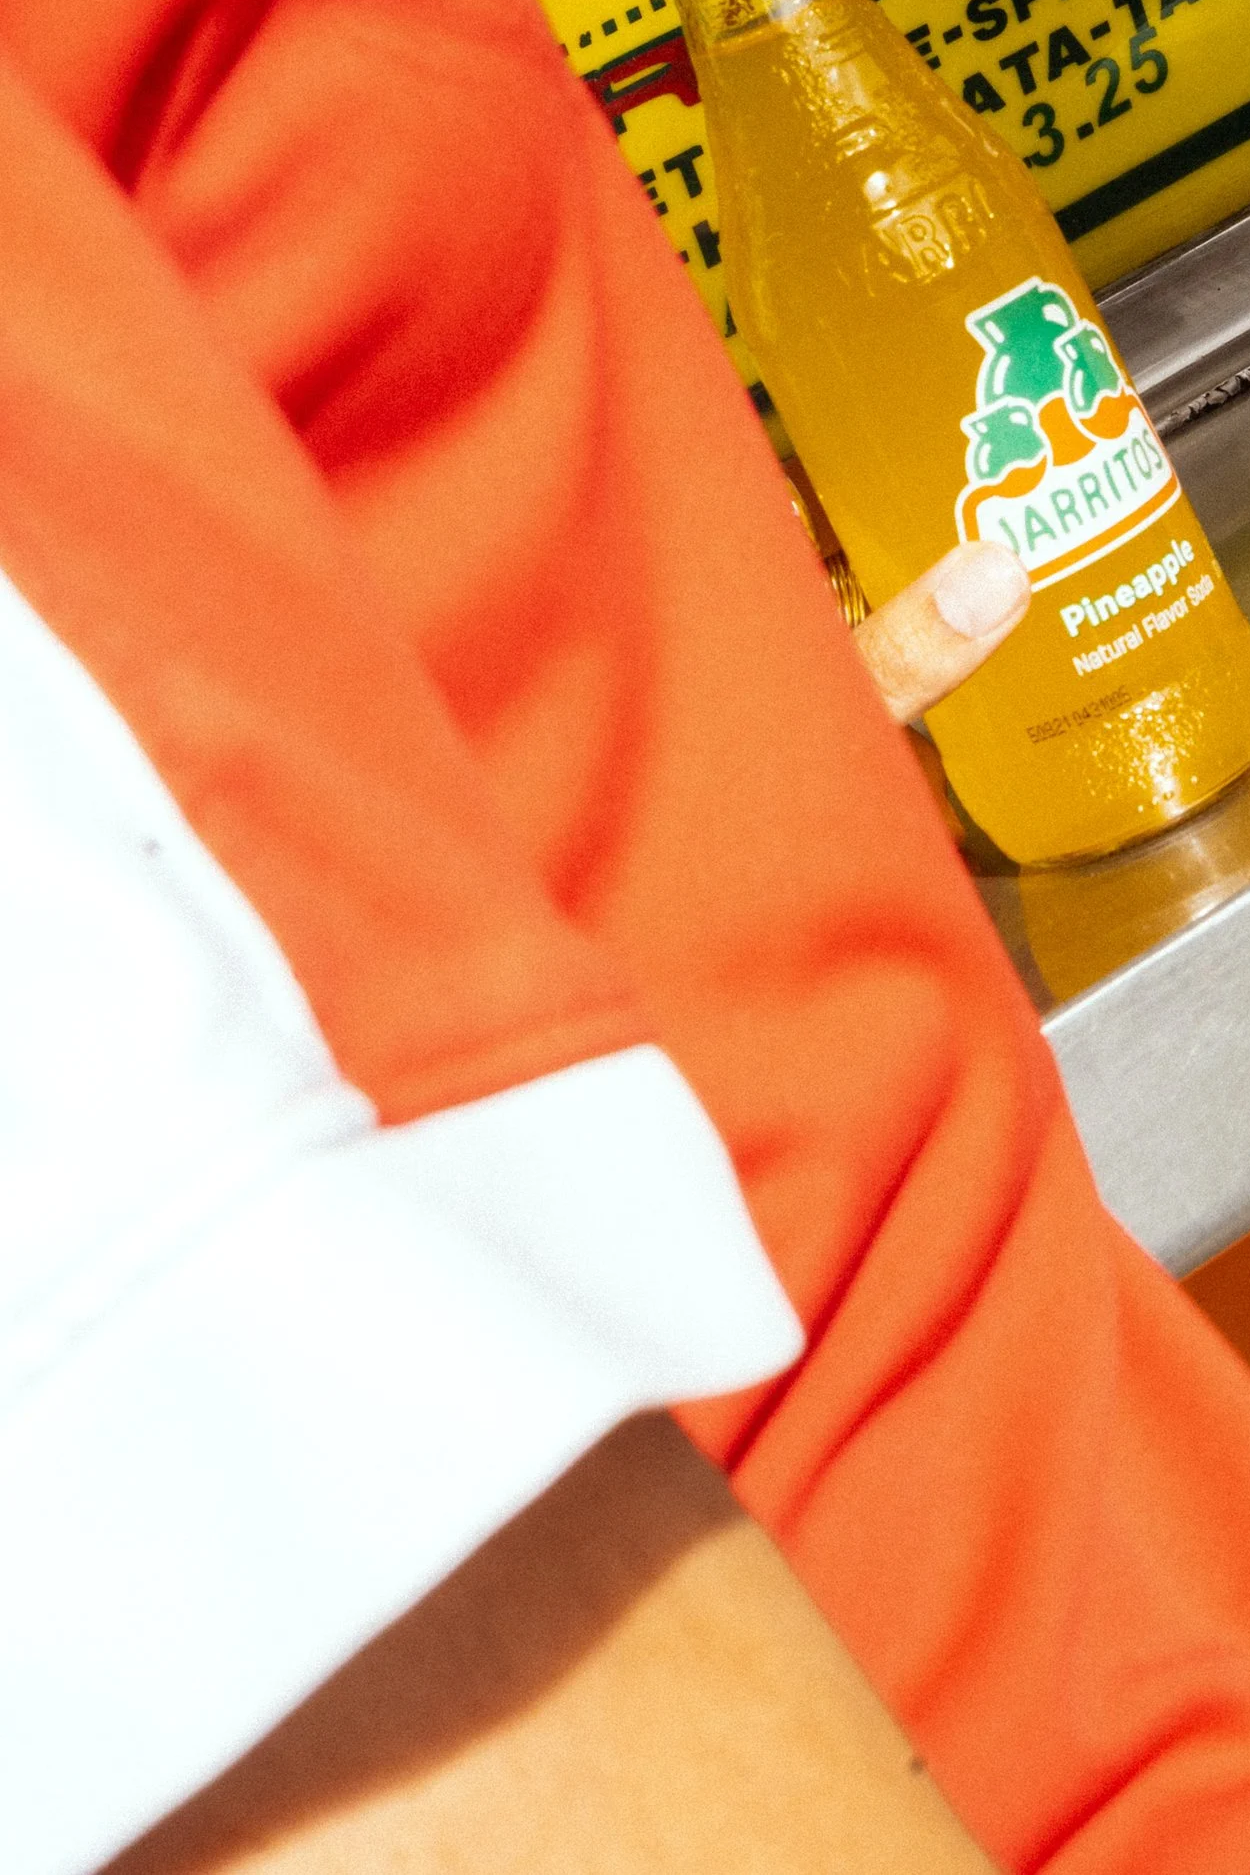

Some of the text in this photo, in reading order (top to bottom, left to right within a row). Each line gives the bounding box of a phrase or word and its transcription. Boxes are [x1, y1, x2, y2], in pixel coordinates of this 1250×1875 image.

[996, 427, 1166, 558] JARRITOS
[1058, 538, 1196, 638] Pineapple
[1071, 623, 1144, 677] Natural
[1140, 595, 1190, 639] Flavor
